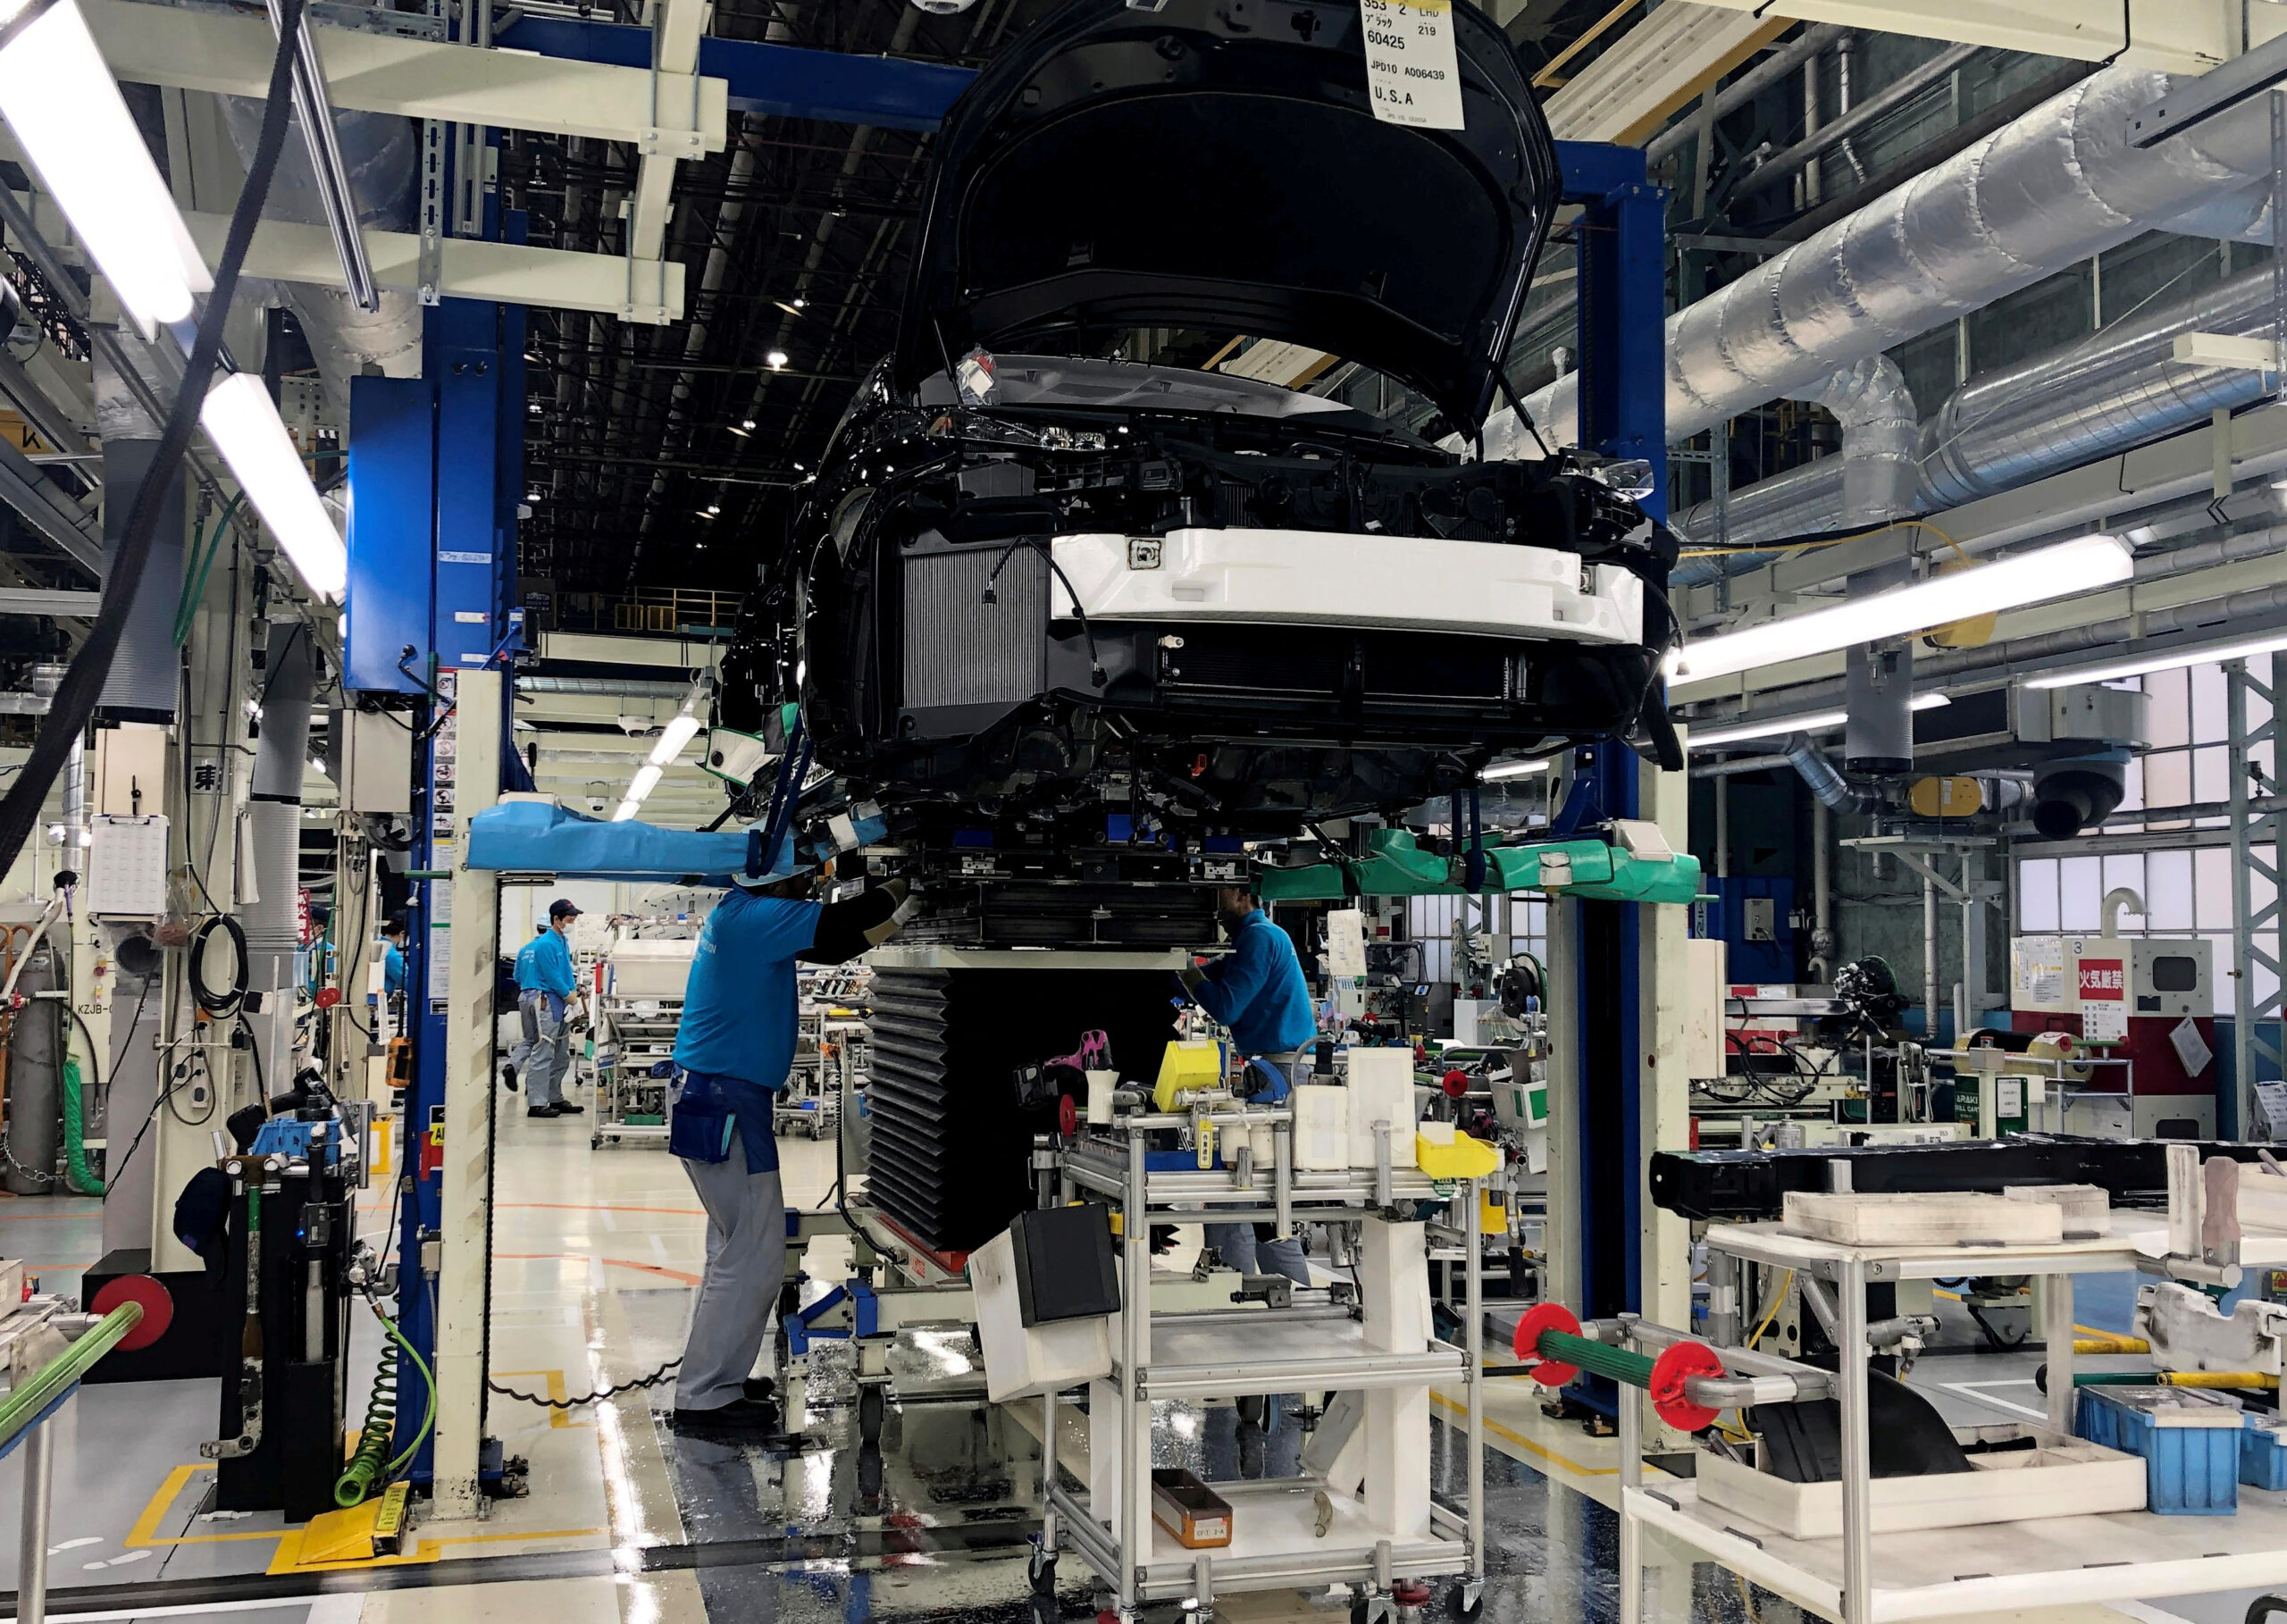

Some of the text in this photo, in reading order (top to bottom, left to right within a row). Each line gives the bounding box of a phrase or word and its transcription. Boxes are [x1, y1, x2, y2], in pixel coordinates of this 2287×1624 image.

[1398, 3, 1406, 15] 2
[1418, 25, 1437, 36] 219
[1368, 29, 1405, 50] 60425
[1370, 59, 1445, 80] JPD10 A006439
[1375, 86, 1413, 105] U.S.A
[2073, 942, 2082, 955] 3
[2080, 970, 2124, 990] 火気厳禁
[1956, 1094, 1978, 1104] ARAKI
